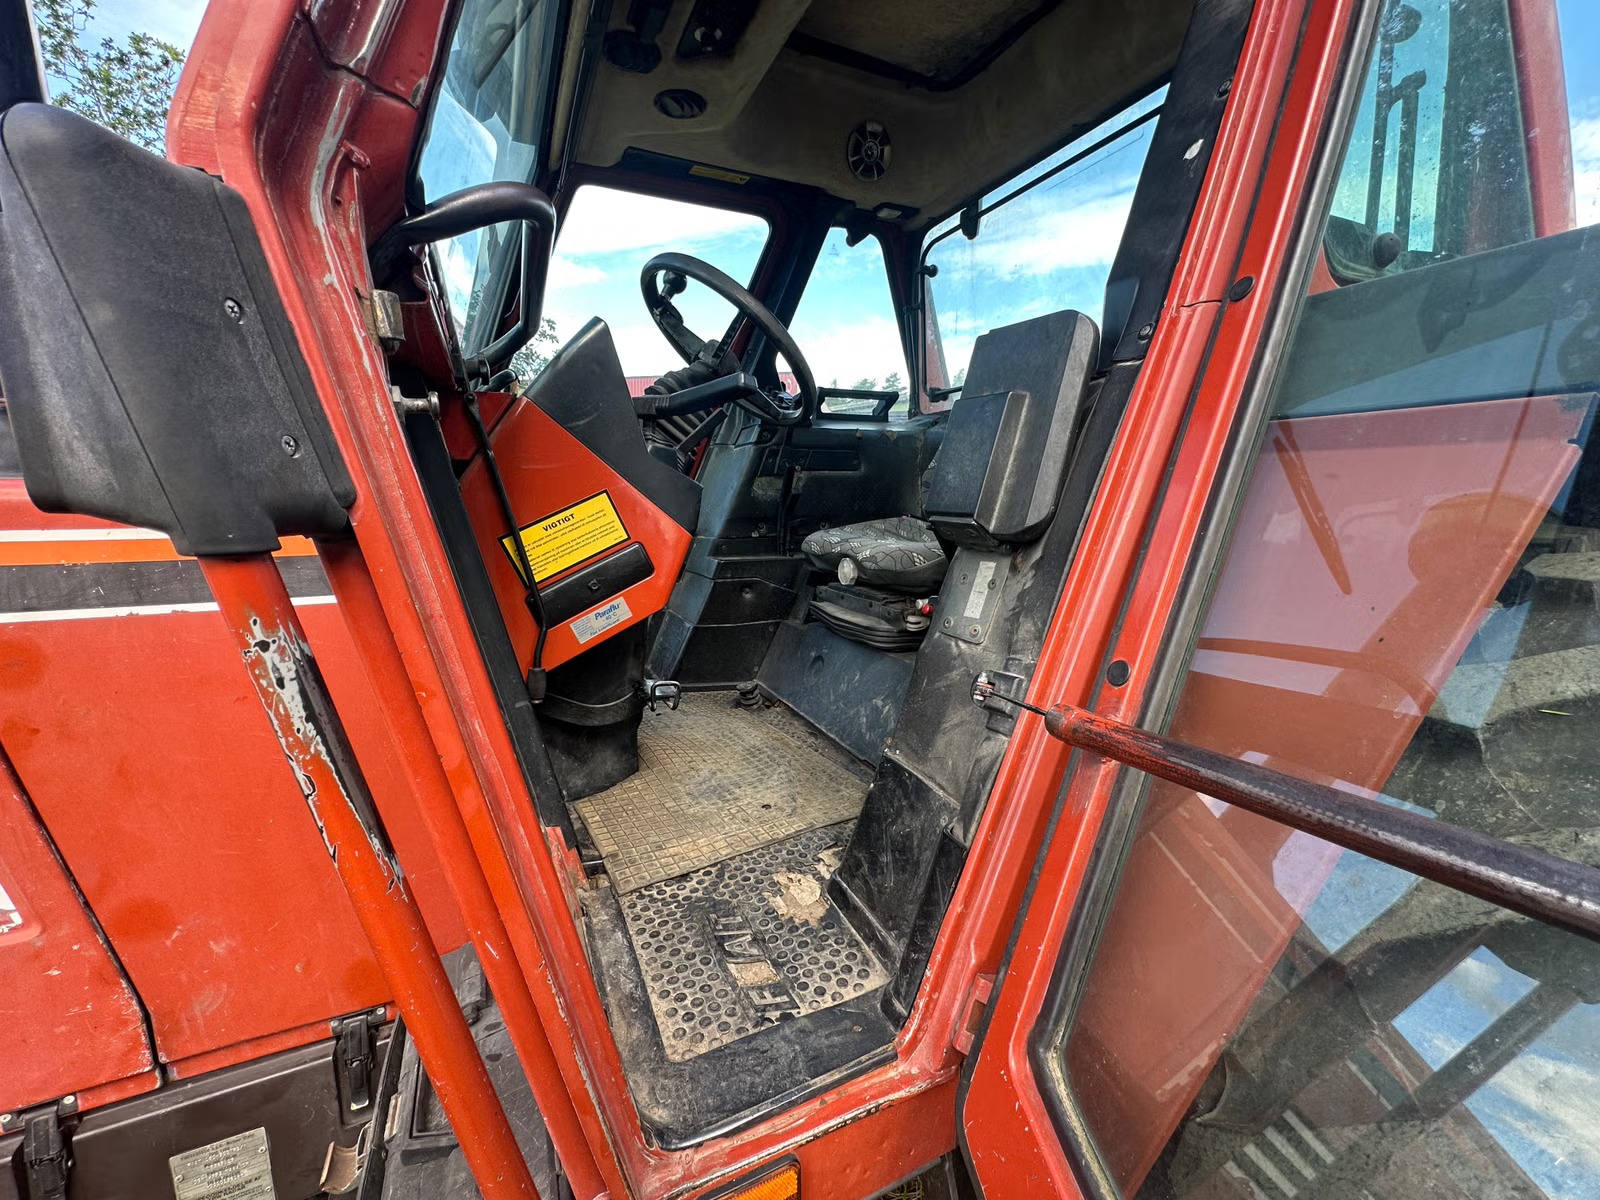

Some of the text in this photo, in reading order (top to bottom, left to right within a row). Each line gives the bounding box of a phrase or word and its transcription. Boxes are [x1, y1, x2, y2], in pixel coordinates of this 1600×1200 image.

[542, 513, 575, 532] VIGTIGT
[594, 603, 619, 621] Paraflu
[709, 912, 791, 1006] FAT
